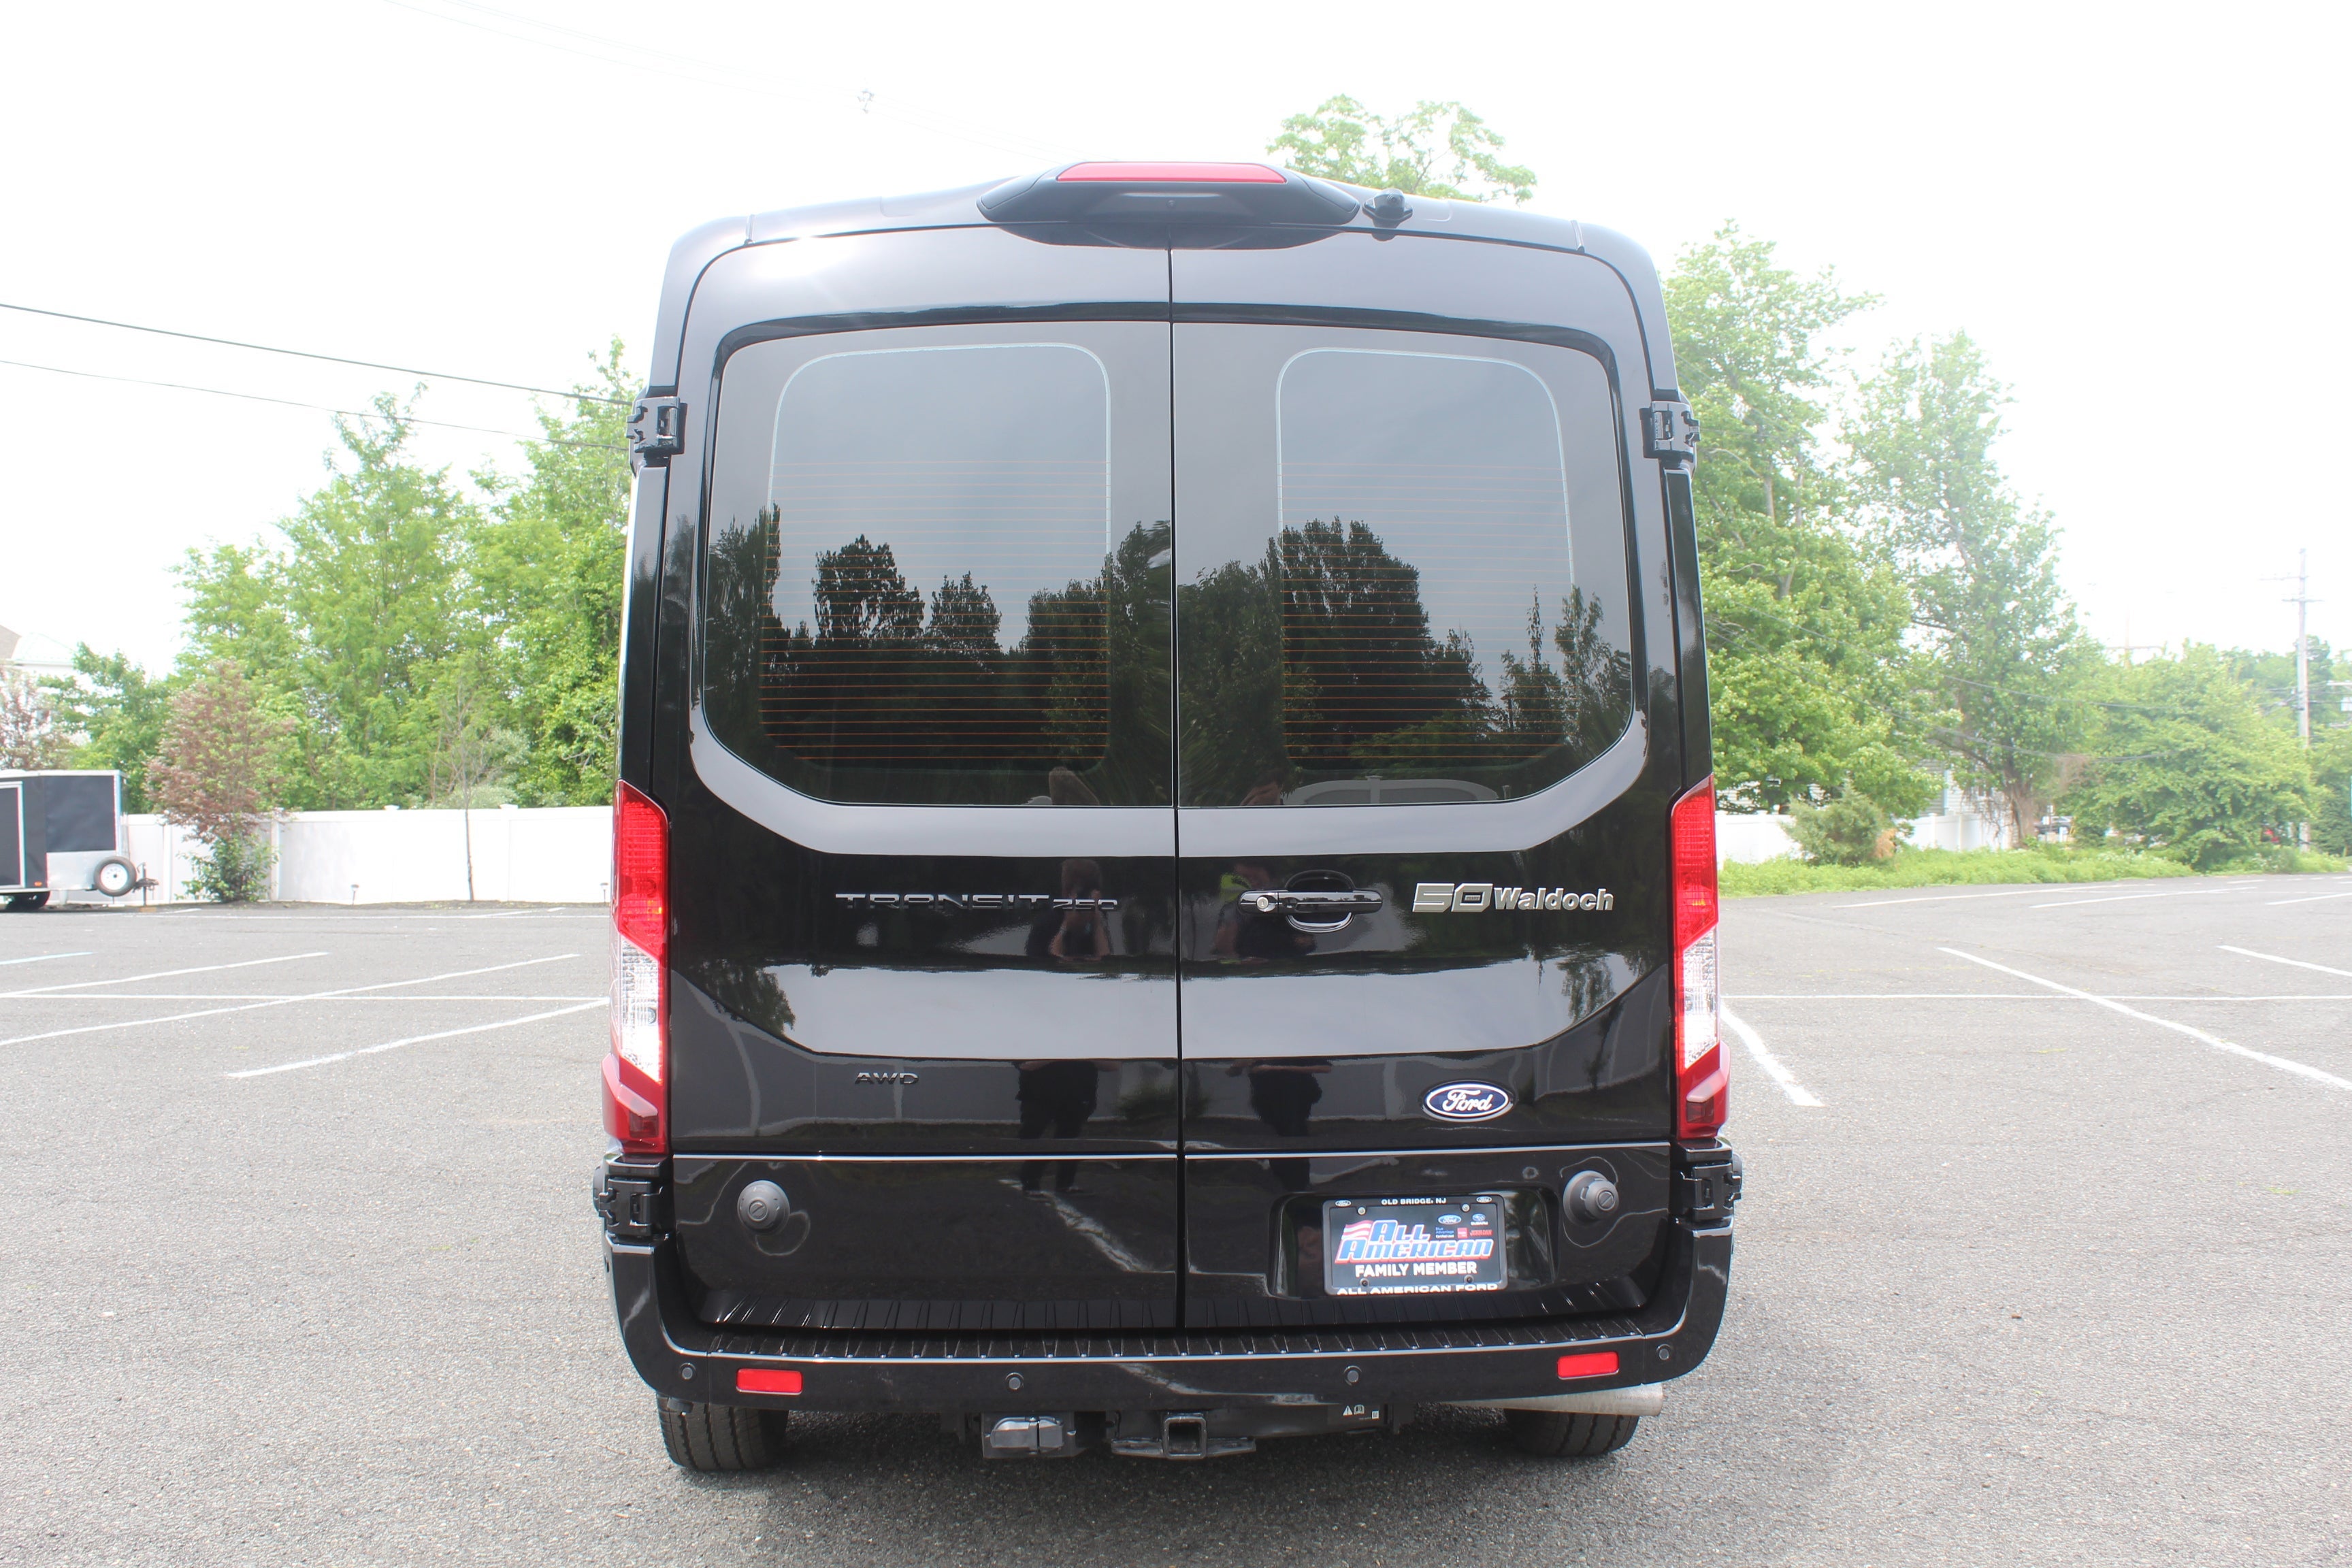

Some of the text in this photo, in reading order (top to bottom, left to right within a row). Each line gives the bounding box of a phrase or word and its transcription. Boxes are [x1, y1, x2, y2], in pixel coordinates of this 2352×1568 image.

[835, 893, 1118, 910] TRANSIT 250
[1412, 883, 1614, 913] 50 Waldoch
[855, 1073, 919, 1084] AWD
[1442, 1089, 1493, 1111] Ford
[1355, 1261, 1477, 1277] FAMILY MEMBER
[1337, 1283, 1499, 1296] ALL AMERICAN FORD
